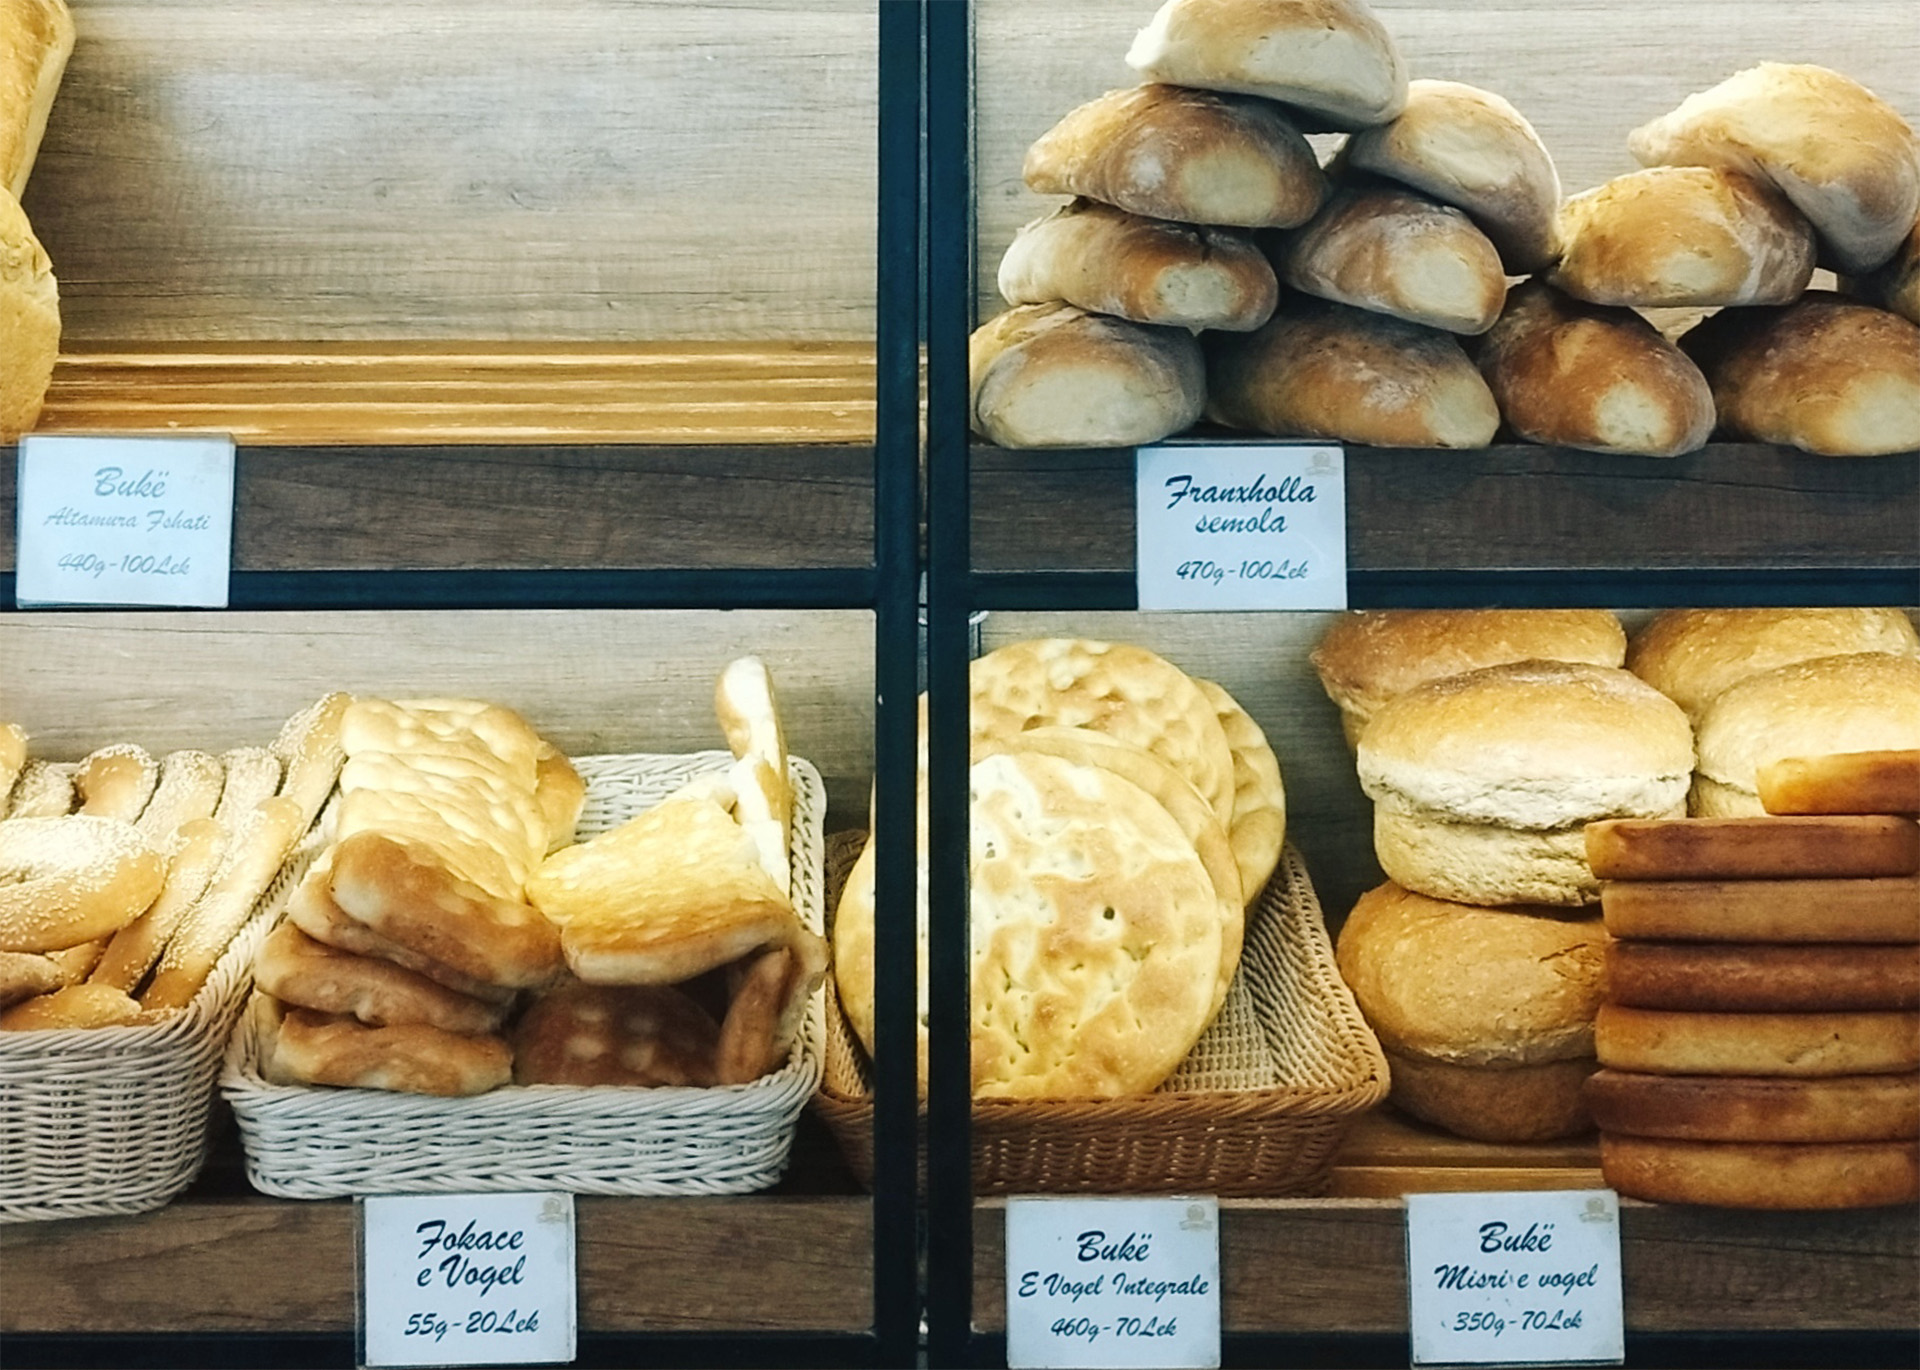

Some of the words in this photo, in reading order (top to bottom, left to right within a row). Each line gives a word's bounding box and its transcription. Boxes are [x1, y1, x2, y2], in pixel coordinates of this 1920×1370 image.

[94, 466, 169, 498] Bukë
[1165, 473, 1317, 509] Franxholla
[43, 507, 137, 527] Altamura
[146, 509, 211, 532] Fshati
[1195, 507, 1288, 533] semola
[1176, 559, 1310, 586] 470g-100Lek
[416, 1219, 523, 1259] Fokace
[1076, 1231, 1152, 1262] Bukë
[1479, 1221, 1554, 1253] Bukë
[417, 1268, 432, 1287] e
[439, 1253, 526, 1297] Vogel
[1018, 1271, 1039, 1298] E
[1043, 1273, 1104, 1303] Vogel
[1112, 1272, 1209, 1303] Integrale
[1434, 1264, 1508, 1290] Misri
[1517, 1273, 1529, 1288] e
[1538, 1263, 1598, 1296] vogel
[404, 1309, 539, 1343] 55g-20Lek
